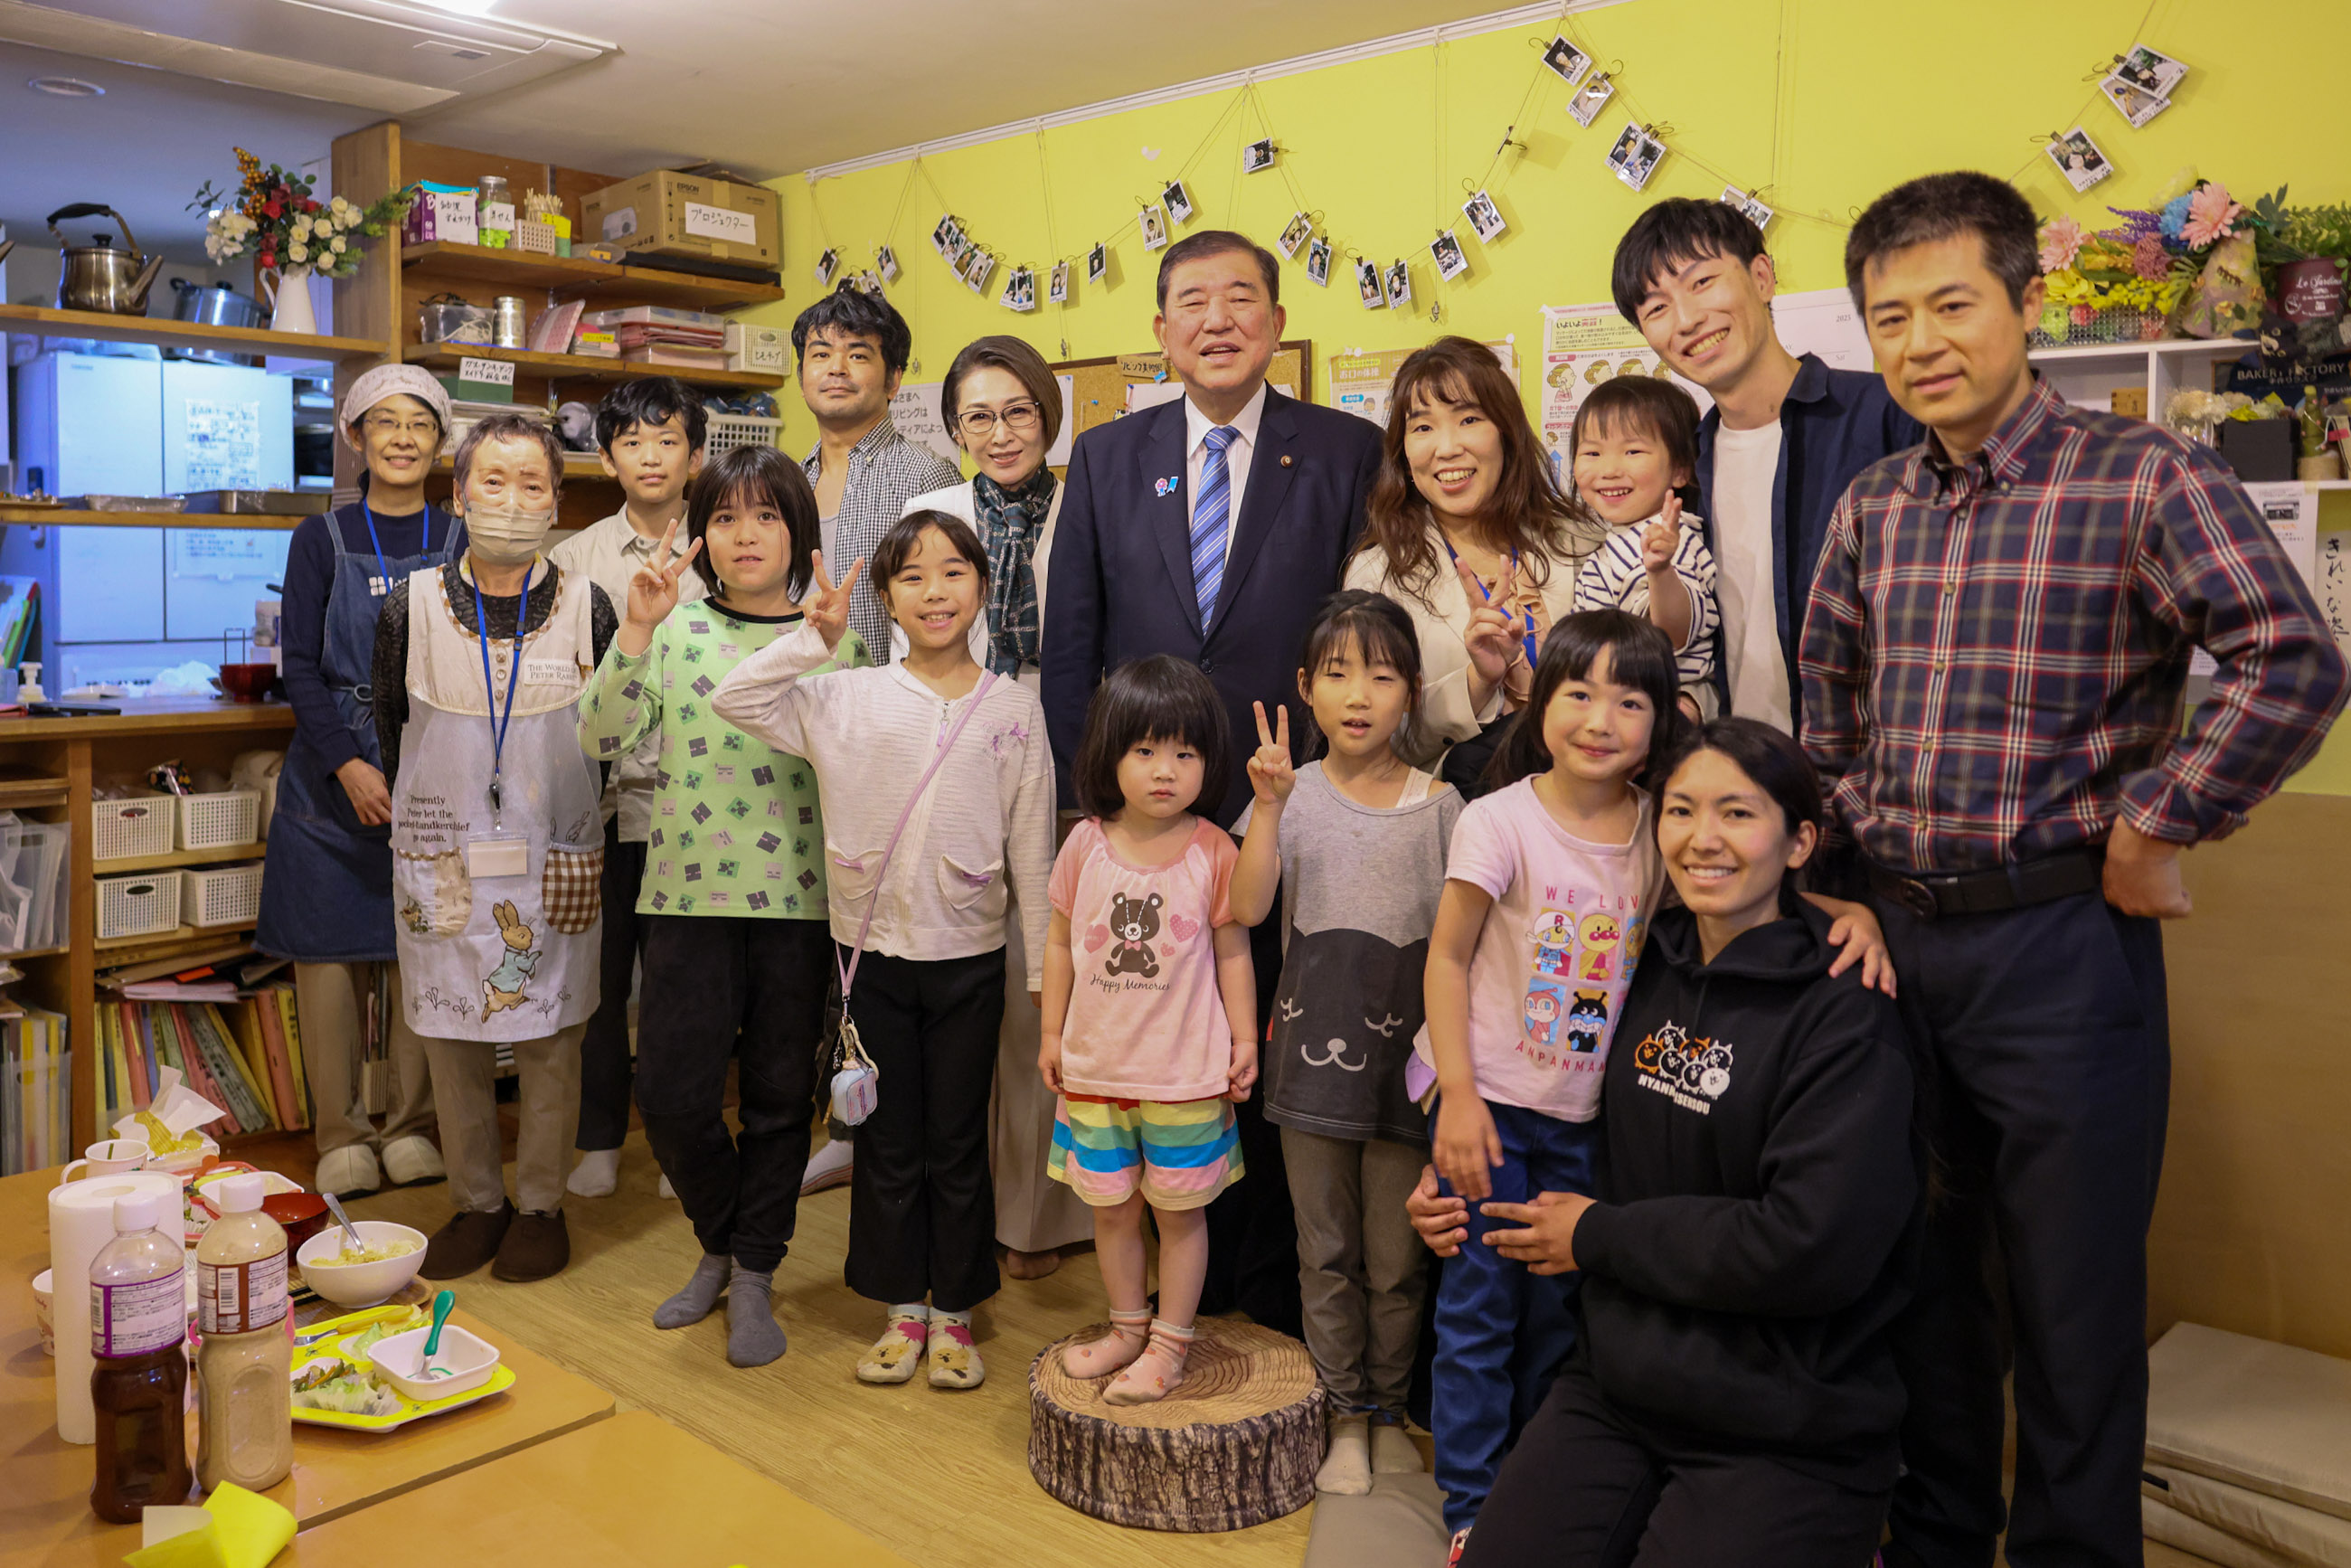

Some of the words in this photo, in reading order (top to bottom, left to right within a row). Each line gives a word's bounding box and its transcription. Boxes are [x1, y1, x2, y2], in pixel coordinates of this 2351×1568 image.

[676, 182, 700, 193] EPSON
[691, 208, 750, 230] プロジェクター
[545, 663, 570, 673] WORLD
[411, 795, 446, 807] Presently
[423, 809, 436, 818] let
[439, 809, 453, 818] the
[420, 832, 448, 844] again.
[1545, 885, 1575, 904] WE
[1554, 915, 1564, 925] R
[1090, 973, 1121, 994] Happy
[1122, 978, 1171, 991] Memories
